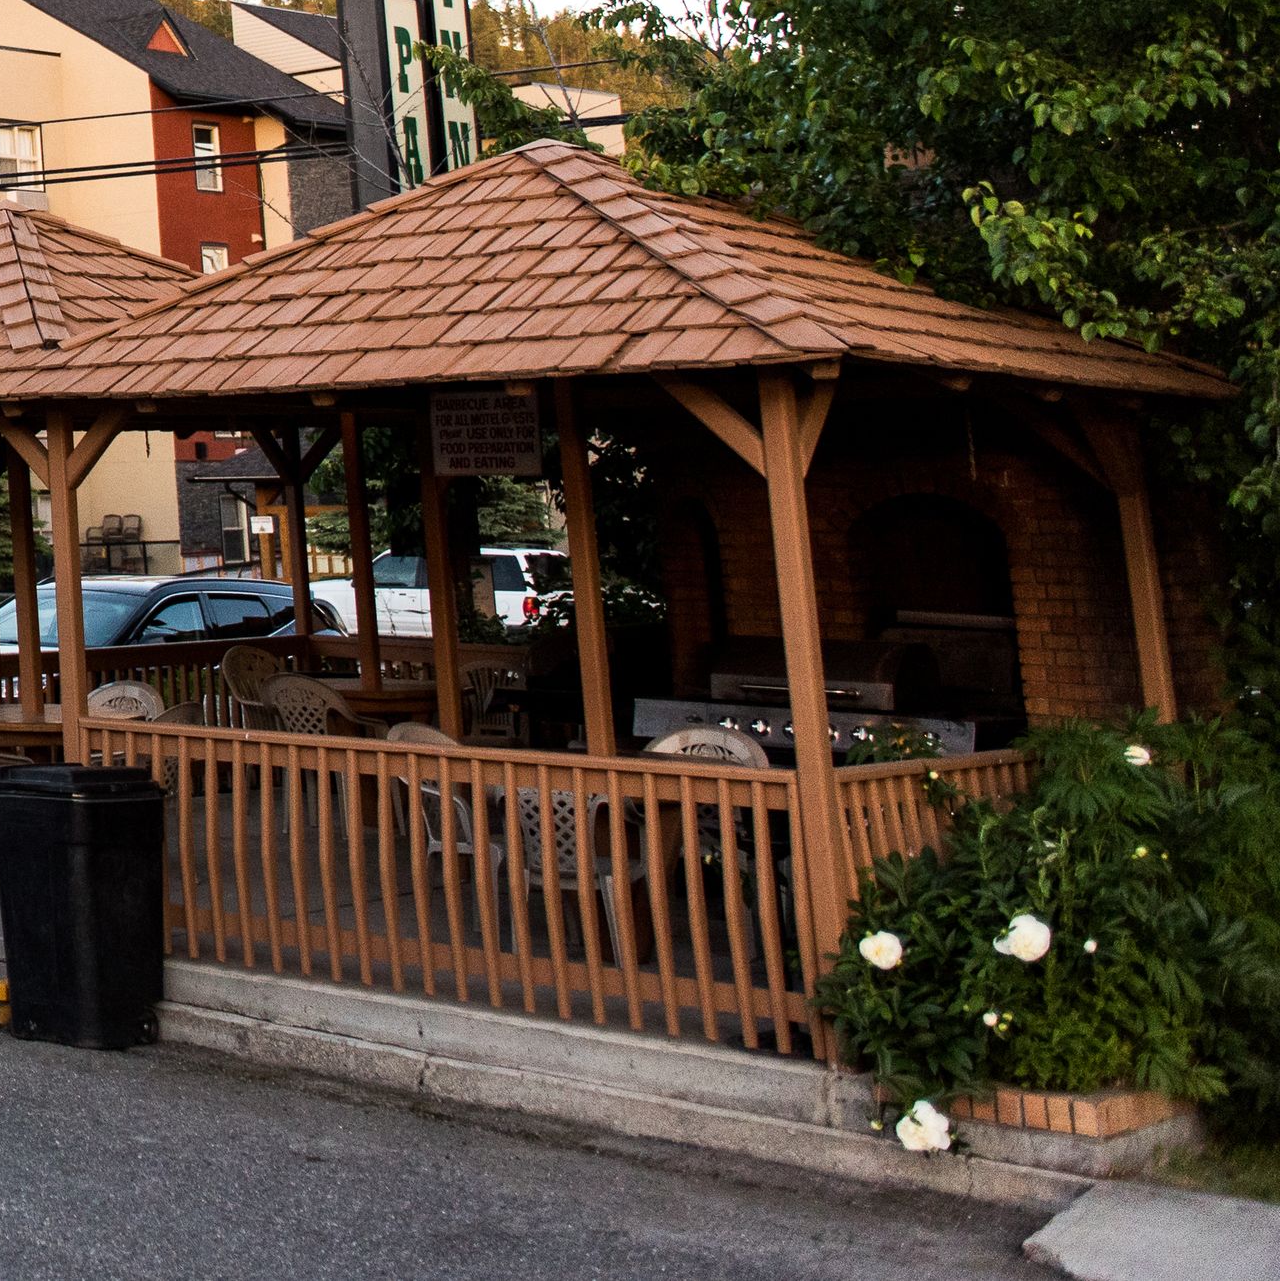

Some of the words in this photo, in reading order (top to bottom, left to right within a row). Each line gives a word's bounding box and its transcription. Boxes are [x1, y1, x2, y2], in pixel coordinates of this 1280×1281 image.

[435, 398, 489, 411] BARBECUE
[493, 396, 526, 409] AREA
[435, 414, 453, 426] FOR
[454, 414, 469, 426] ALL
[470, 413, 501, 425] MOTEL
[466, 427, 488, 439] USE
[489, 426, 513, 439] ONLY
[516, 426, 535, 438] FOR
[440, 443, 466, 454] FOOD
[468, 441, 535, 454] PREPARATION
[449, 457, 471, 469] AND
[474, 457, 516, 469] EATING
